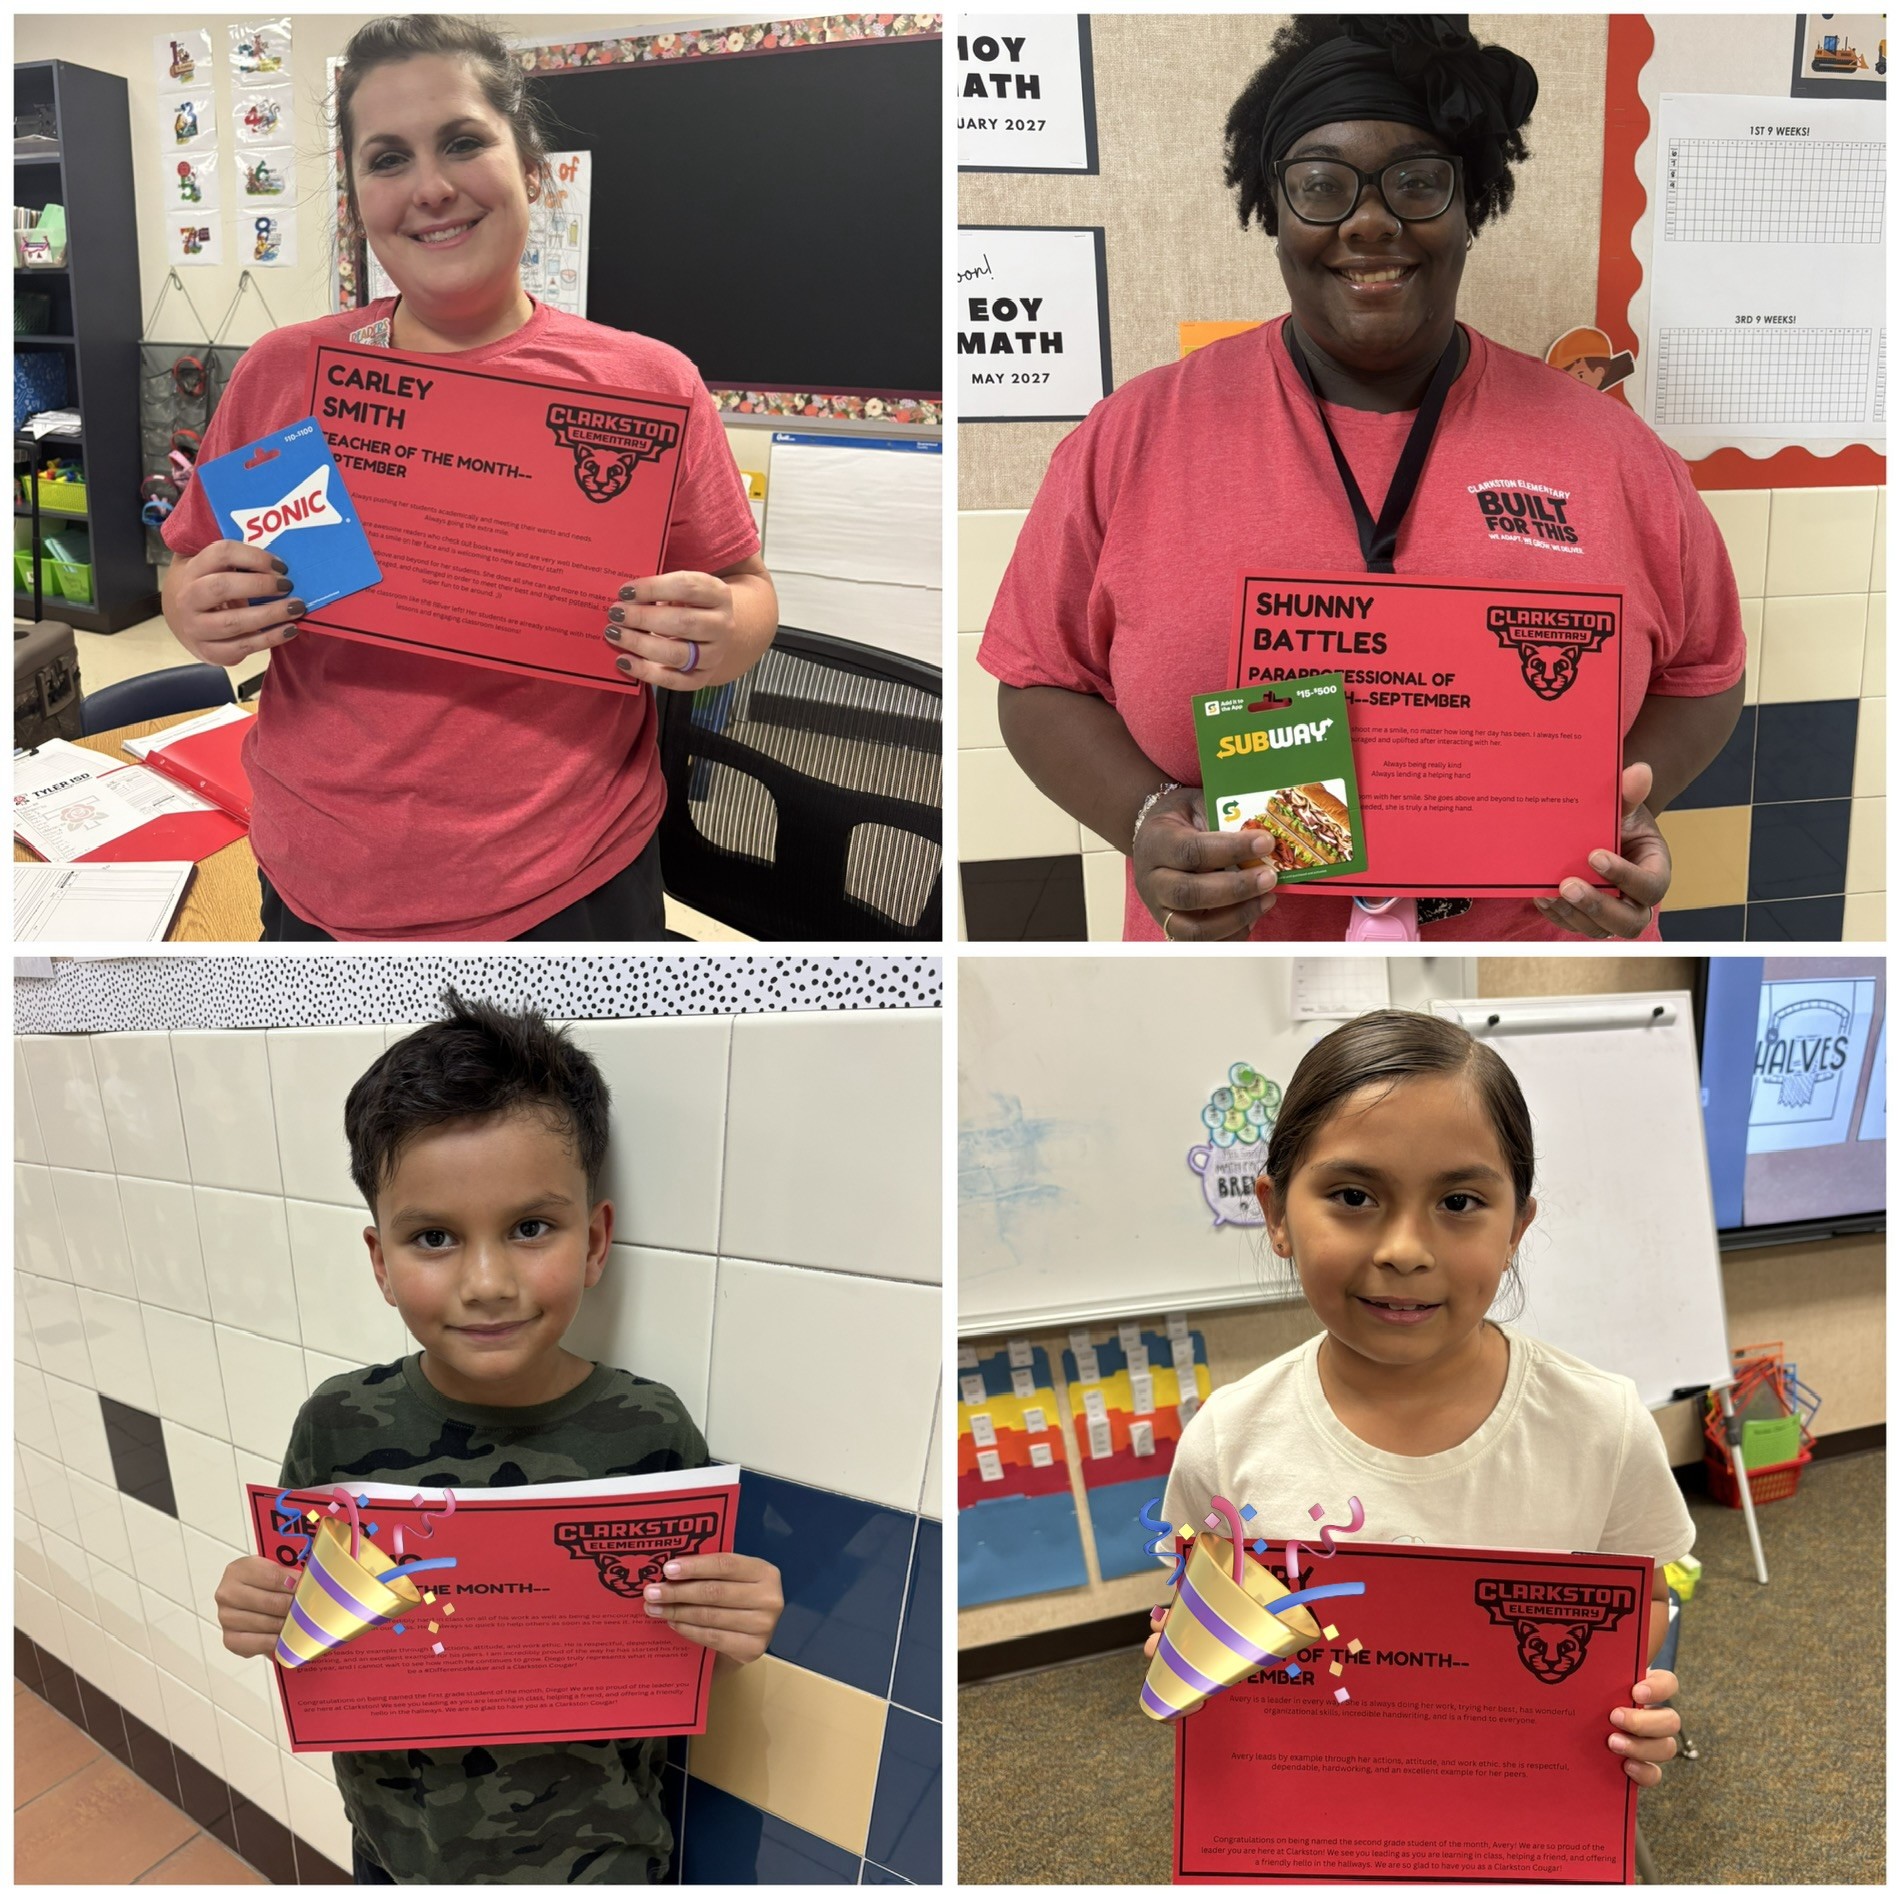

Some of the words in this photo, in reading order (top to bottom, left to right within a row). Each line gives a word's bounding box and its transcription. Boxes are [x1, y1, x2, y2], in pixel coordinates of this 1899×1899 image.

[958, 73, 1040, 99] ATH
[1004, 119, 1046, 131] 2027
[1750, 126, 1765, 136] 1ST
[1767, 127, 1774, 136] 9
[1776, 127, 1810, 136] WEEKS!
[968, 297, 1043, 322] EOY
[1735, 316, 1753, 324] 3RD
[1756, 316, 1762, 324] 9
[1764, 316, 1796, 324] WEEKS!
[958, 331, 1064, 354] MATH
[327, 364, 434, 400] CARLEY
[972, 374, 1004, 384] MAY
[1011, 372, 1051, 384] 2027
[323, 396, 407, 430] SMITH
[550, 406, 677, 448] CLARKSTON
[572, 430, 648, 449] ELEMENTARY
[394, 445, 418, 459] OF
[421, 449, 454, 466] THE
[1467, 479, 1518, 494] CLARKSTON
[1518, 480, 1571, 499] ELEMENTARY
[246, 490, 326, 542] SONIC
[1476, 490, 1568, 524] BUILT
[1485, 516, 1530, 535] FOR
[1531, 520, 1579, 544] THIS
[1256, 592, 1374, 620] SHUNNY
[1490, 608, 1613, 632] CLARKSTON
[1253, 628, 1388, 655] BATTLES
[1514, 628, 1587, 642] ELEMENTARY
[1432, 673, 1456, 686] OF
[1232, 704, 1242, 712] App
[1216, 718, 1334, 759] SUBWAY
[1459, 728, 1474, 737] long
[1486, 730, 1499, 738] day
[1536, 731, 1559, 740] always
[1382, 760, 1407, 769] Always
[1407, 761, 1427, 769] being
[1427, 761, 1446, 769] really
[32, 781, 69, 798] TYLER
[69, 772, 91, 784] ISD
[1370, 770, 1395, 779] Always
[1396, 770, 1421, 779] lending
[1427, 771, 1453, 780] helping
[1405, 804, 1422, 812] truly
[1428, 804, 1454, 813] helping
[1754, 1036, 1849, 1076] HALVES
[558, 1516, 714, 1541] CLARKSTON
[590, 1538, 682, 1550] ELEMENTARY
[1479, 1582, 1632, 1608] CLARKSTON
[1509, 1604, 1600, 1618] ELEMENTARY
[1297, 1648, 1324, 1663] OF
[1330, 1649, 1371, 1665] THE
[1231, 1752, 1254, 1762] Avery
[1255, 1752, 1276, 1760] leads
[1278, 1753, 1288, 1762] by
[1289, 1753, 1323, 1762] example
[1324, 1754, 1356, 1764] through
[1357, 1755, 1371, 1763] her
[1372, 1756, 1403, 1765] actions,
[1405, 1757, 1439, 1766] attitude,
[1457, 1759, 1477, 1767] work
[1478, 1759, 1501, 1767] ethic.
[1502, 1760, 1516, 1768] she
[1526, 1762, 1569, 1771] respectful,
[1271, 1762, 1320, 1772] dependable,
[1321, 1764, 1373, 1774] hardworking,
[1402, 1767, 1438, 1775] excellent
[1440, 1768, 1473, 1777] example
[1475, 1768, 1487, 1776] for
